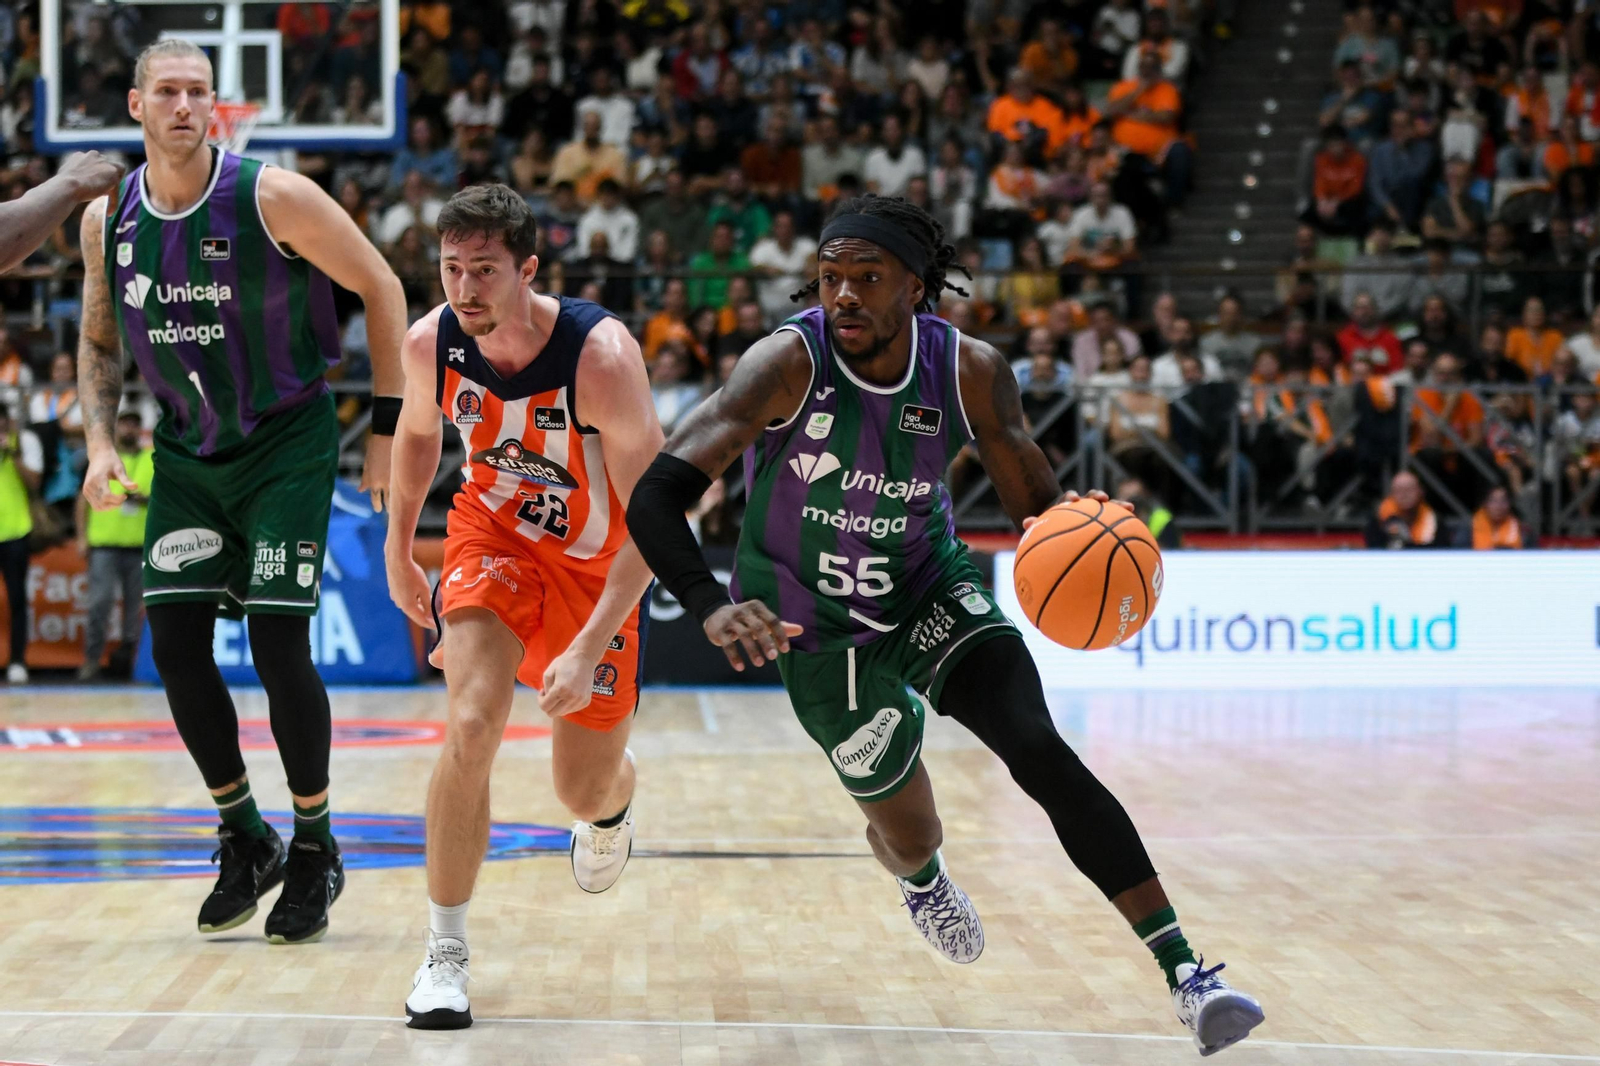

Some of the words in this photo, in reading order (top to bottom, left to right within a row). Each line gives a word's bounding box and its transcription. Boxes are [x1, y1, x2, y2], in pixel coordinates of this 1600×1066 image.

[156, 281, 232, 308] Unicaja
[147, 320, 226, 346] málaga
[188, 371, 208, 408] 1
[536, 414, 550, 423] liga
[537, 421, 565, 429] endesa
[903, 421, 936, 432] endesa
[904, 413, 920, 423] liga
[485, 455, 558, 477] Estrella
[840, 470, 932, 503] Unicaja
[515, 489, 570, 540] 22
[802, 506, 908, 539] málaga
[299, 547, 314, 555] acb
[817, 551, 894, 597] 55
[953, 587, 972, 597] acb
[1118, 595, 1133, 622] liga
